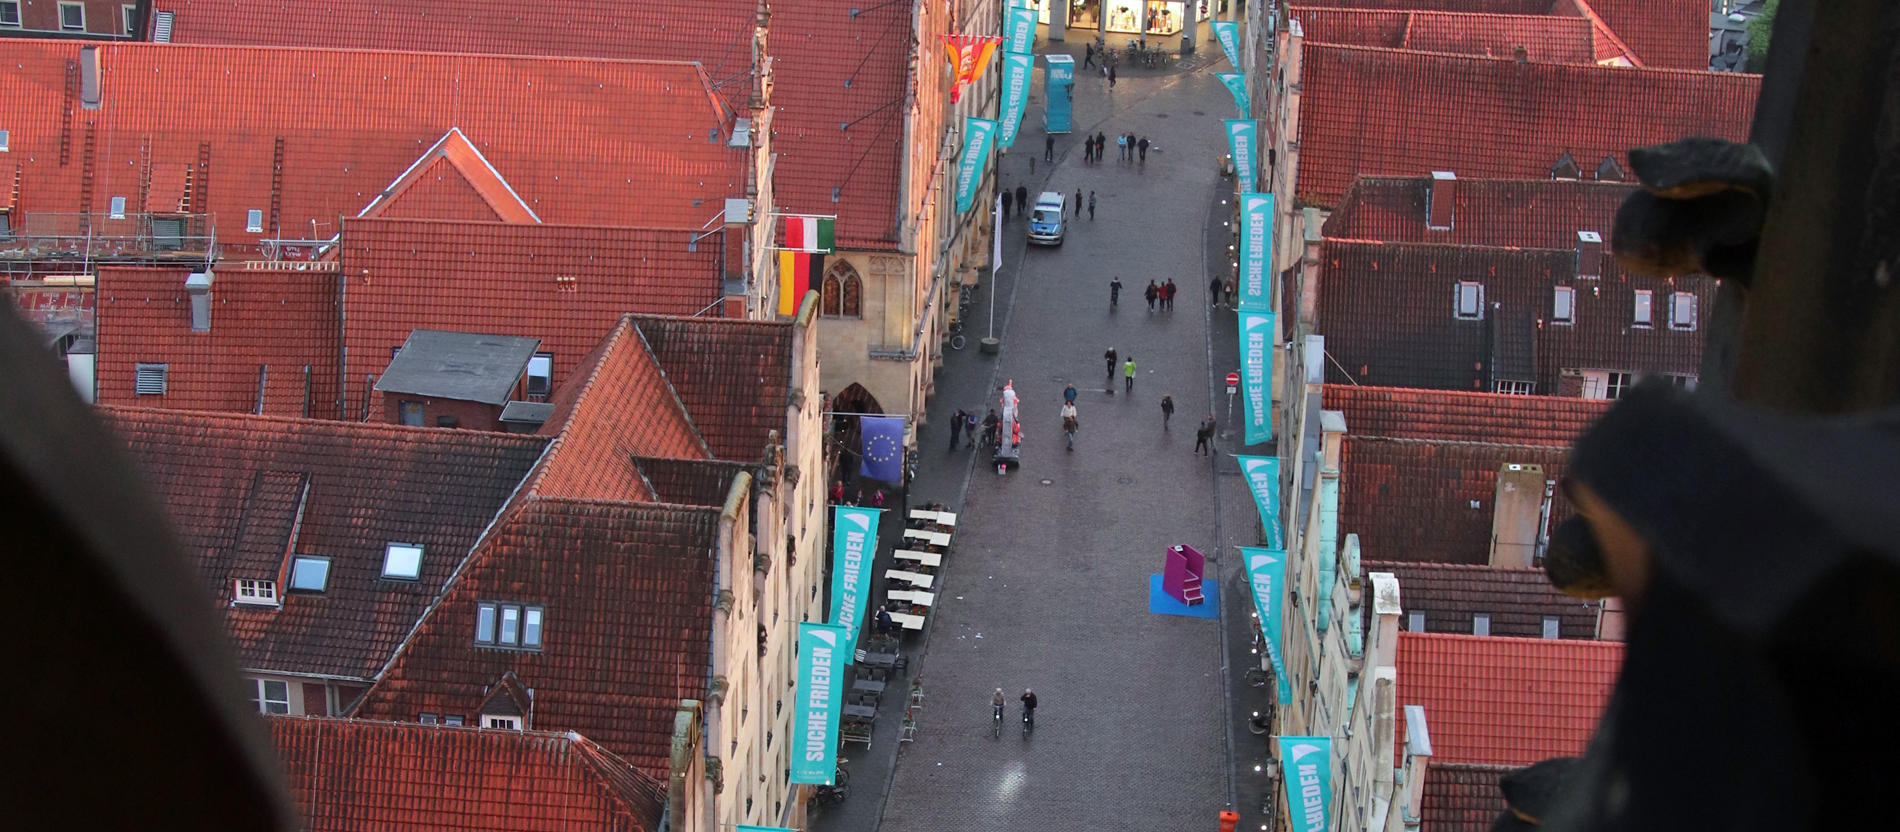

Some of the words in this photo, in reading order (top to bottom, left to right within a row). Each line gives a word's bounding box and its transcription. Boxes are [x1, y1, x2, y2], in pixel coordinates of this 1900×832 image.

[1012, 21, 1030, 53] RIEDEN
[1009, 66, 1025, 107] FRIEDEN
[1003, 104, 1019, 138] SUCHE
[842, 530, 865, 594] FRIEDEN
[810, 647, 832, 710] FRIEDEN
[805, 711, 828, 762] SUCHE
